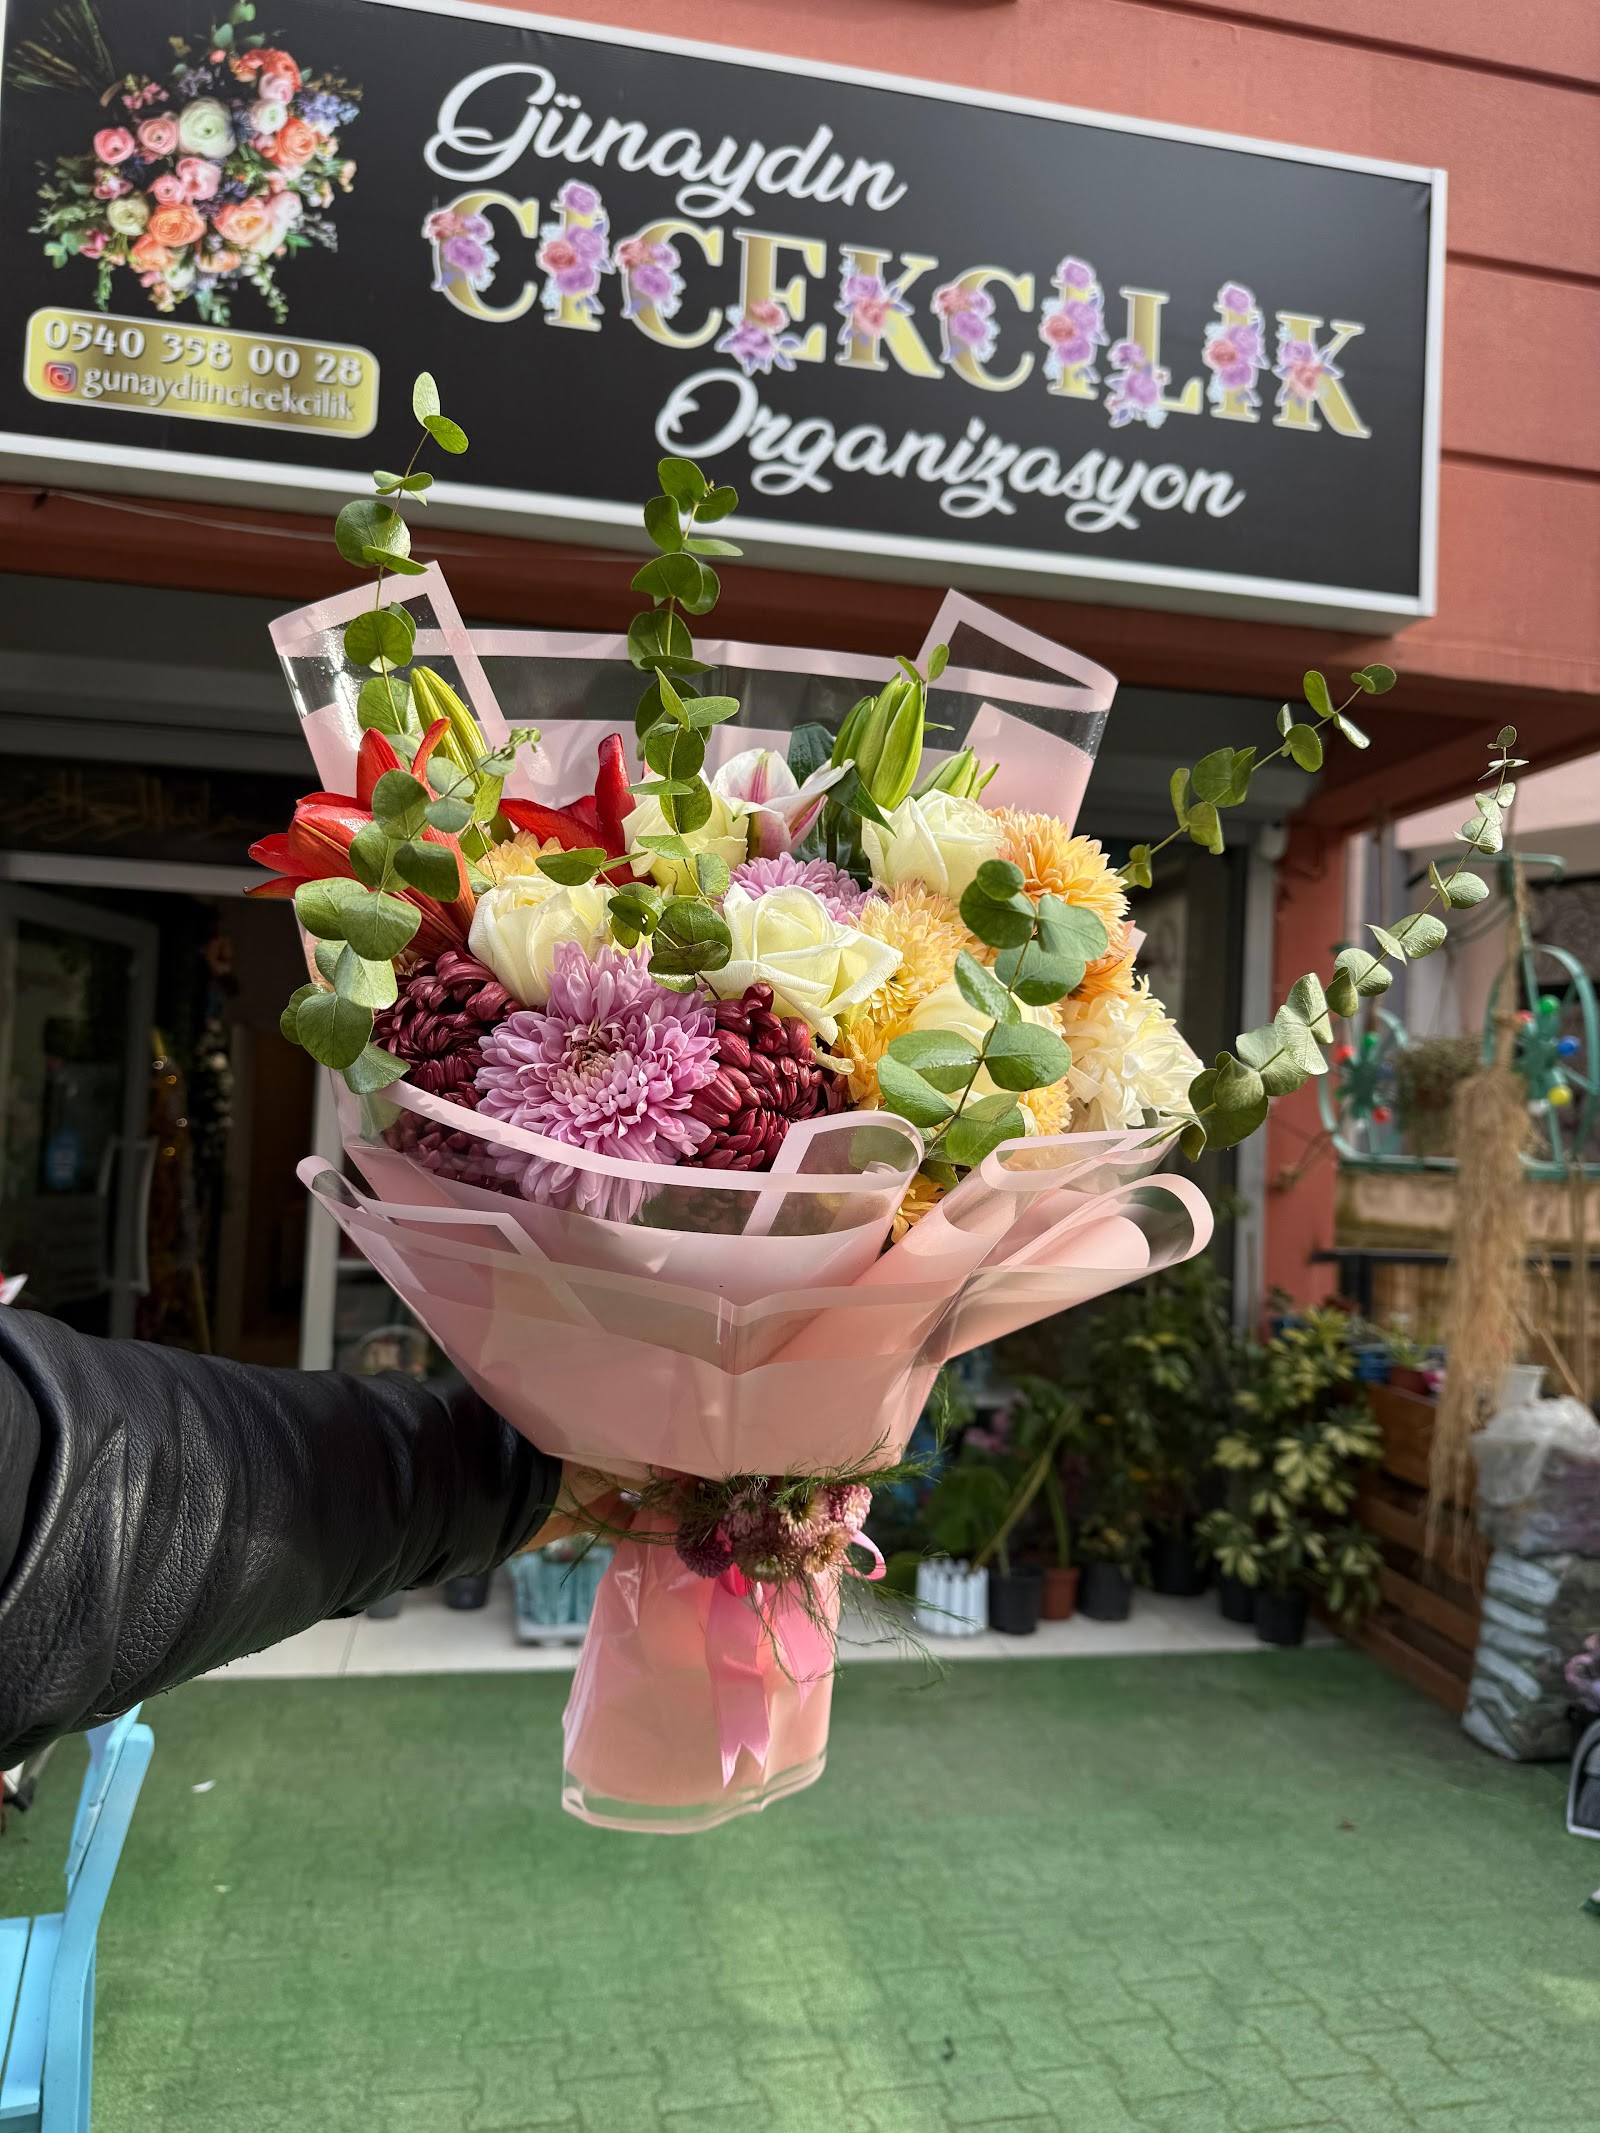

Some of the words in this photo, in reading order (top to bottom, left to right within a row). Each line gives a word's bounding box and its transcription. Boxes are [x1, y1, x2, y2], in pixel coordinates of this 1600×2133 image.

[424, 62, 908, 218] Günaydın
[44, 318, 146, 358] 0540
[159, 333, 232, 370] 358
[248, 344, 300, 379] 00
[315, 352, 363, 387] 28
[80, 367, 355, 420] gunaydiincicekcilik
[654, 368, 1246, 533] Organizasyon
